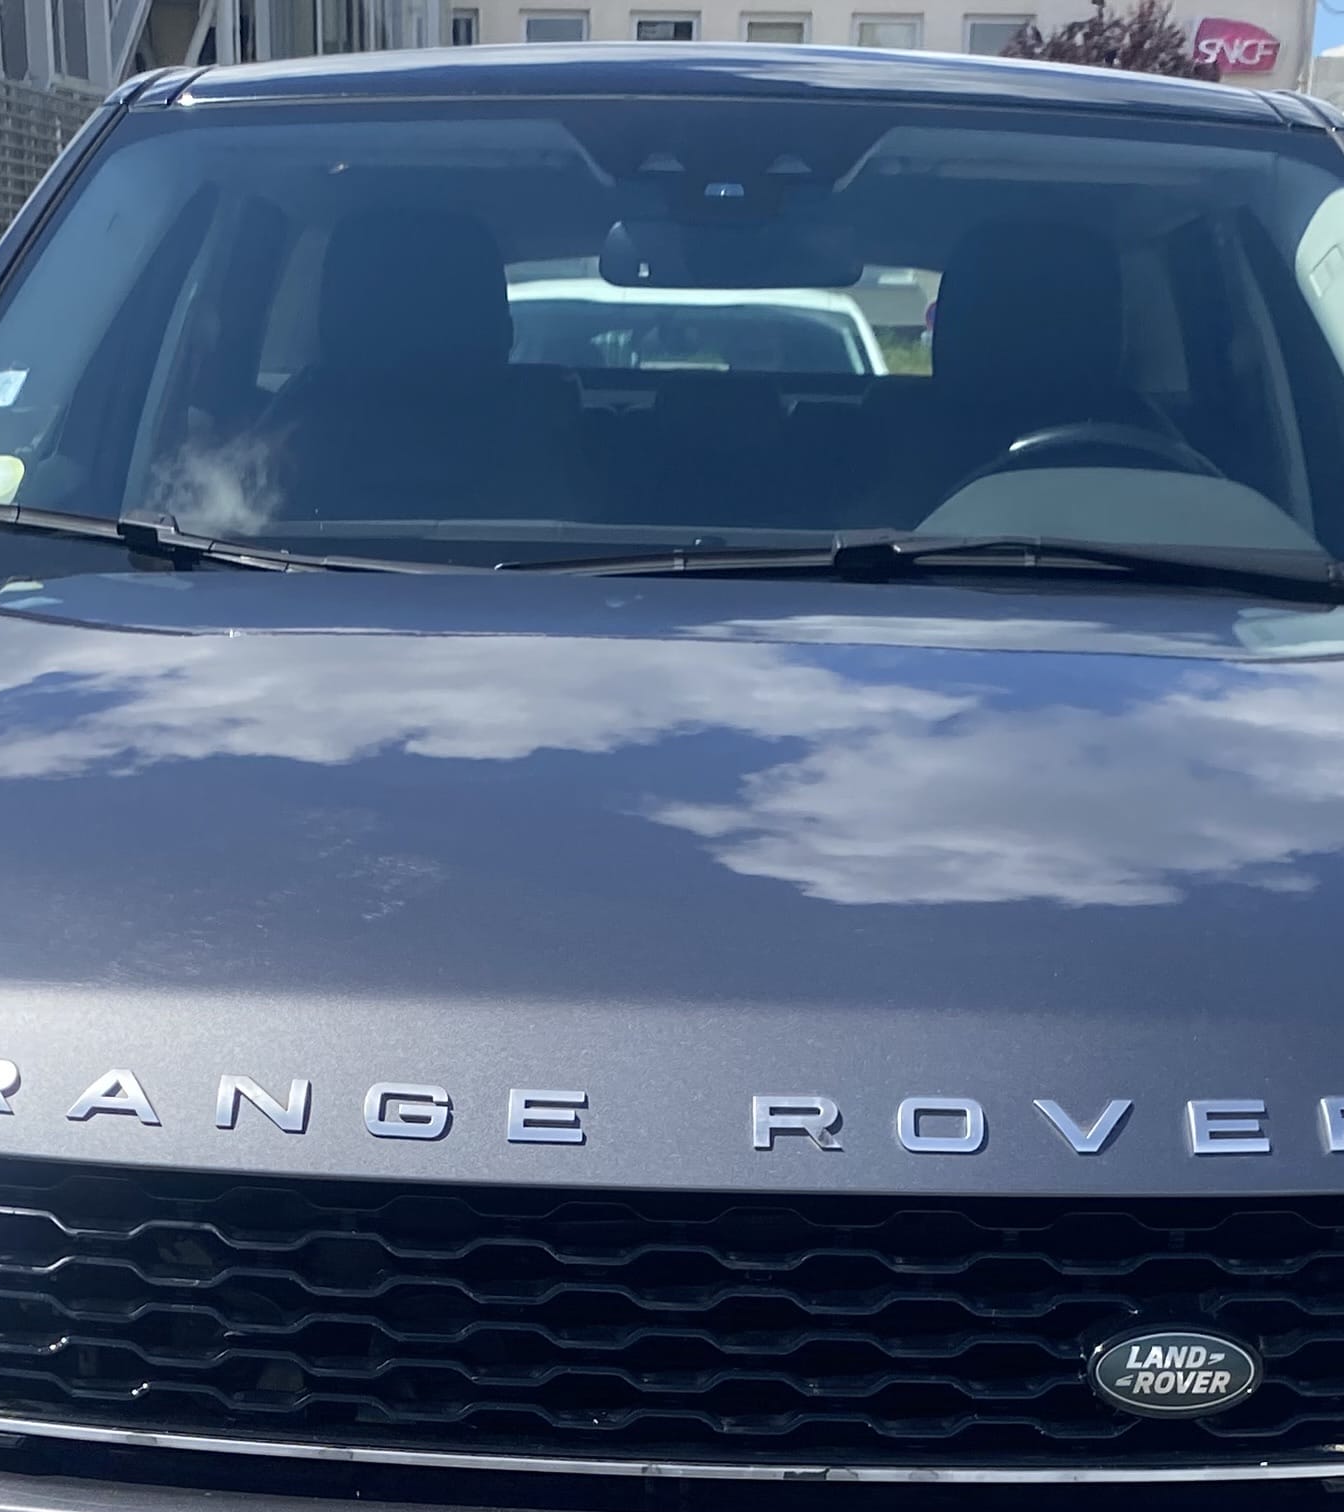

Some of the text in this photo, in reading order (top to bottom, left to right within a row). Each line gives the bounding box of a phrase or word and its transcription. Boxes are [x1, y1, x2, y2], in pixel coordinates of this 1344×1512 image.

[1197, 38, 1282, 64] SNCF
[1126, 1346, 1207, 1369] LAND
[1132, 1371, 1231, 1394] ROVER
